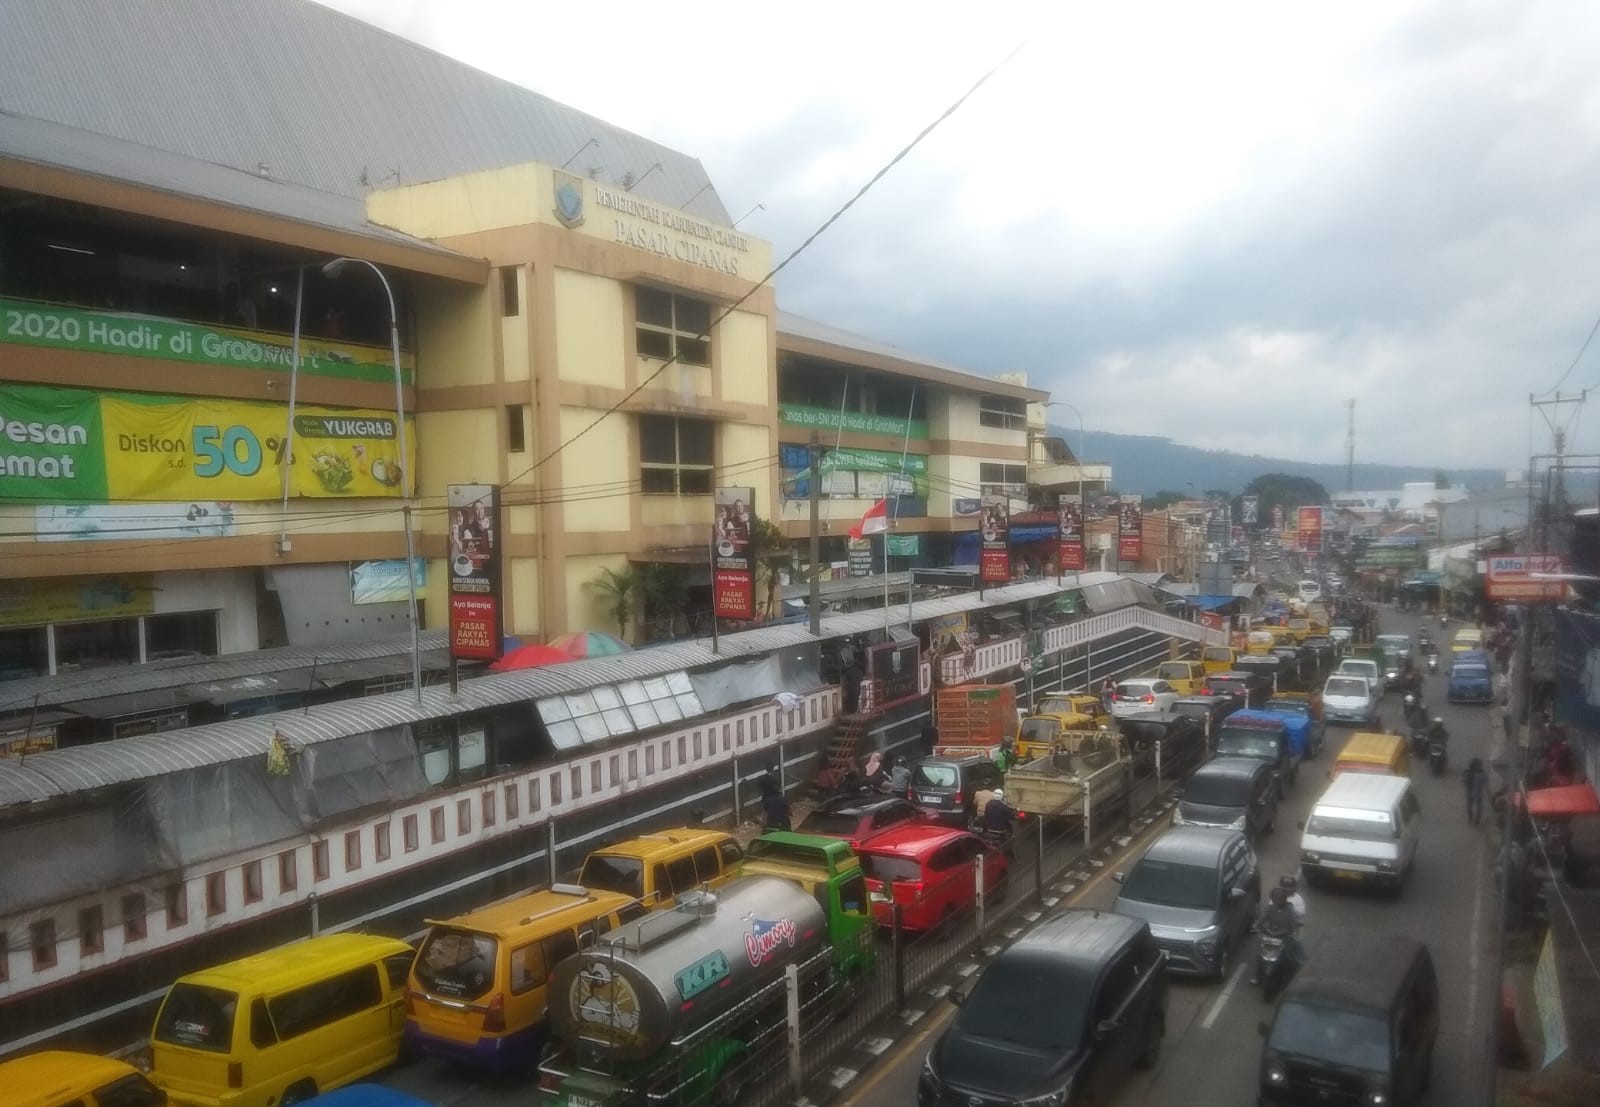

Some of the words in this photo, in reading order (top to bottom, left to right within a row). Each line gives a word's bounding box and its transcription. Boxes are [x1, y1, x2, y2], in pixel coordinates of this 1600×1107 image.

[614, 220, 672, 257] PASAR
[674, 239, 738, 276] CIPANAS
[6, 310, 81, 343] 2020
[87, 320, 162, 353] Hadir
[169, 330, 193, 355] di
[0, 416, 87, 445] esan
[323, 420, 393, 436] YUKGRAB
[118, 433, 187, 455] Diskon
[457, 630, 488, 639] RAKYAT
[460, 622, 485, 631] PASAR
[456, 638, 490, 647] CIPANAS
[681, 954, 727, 993] KR
